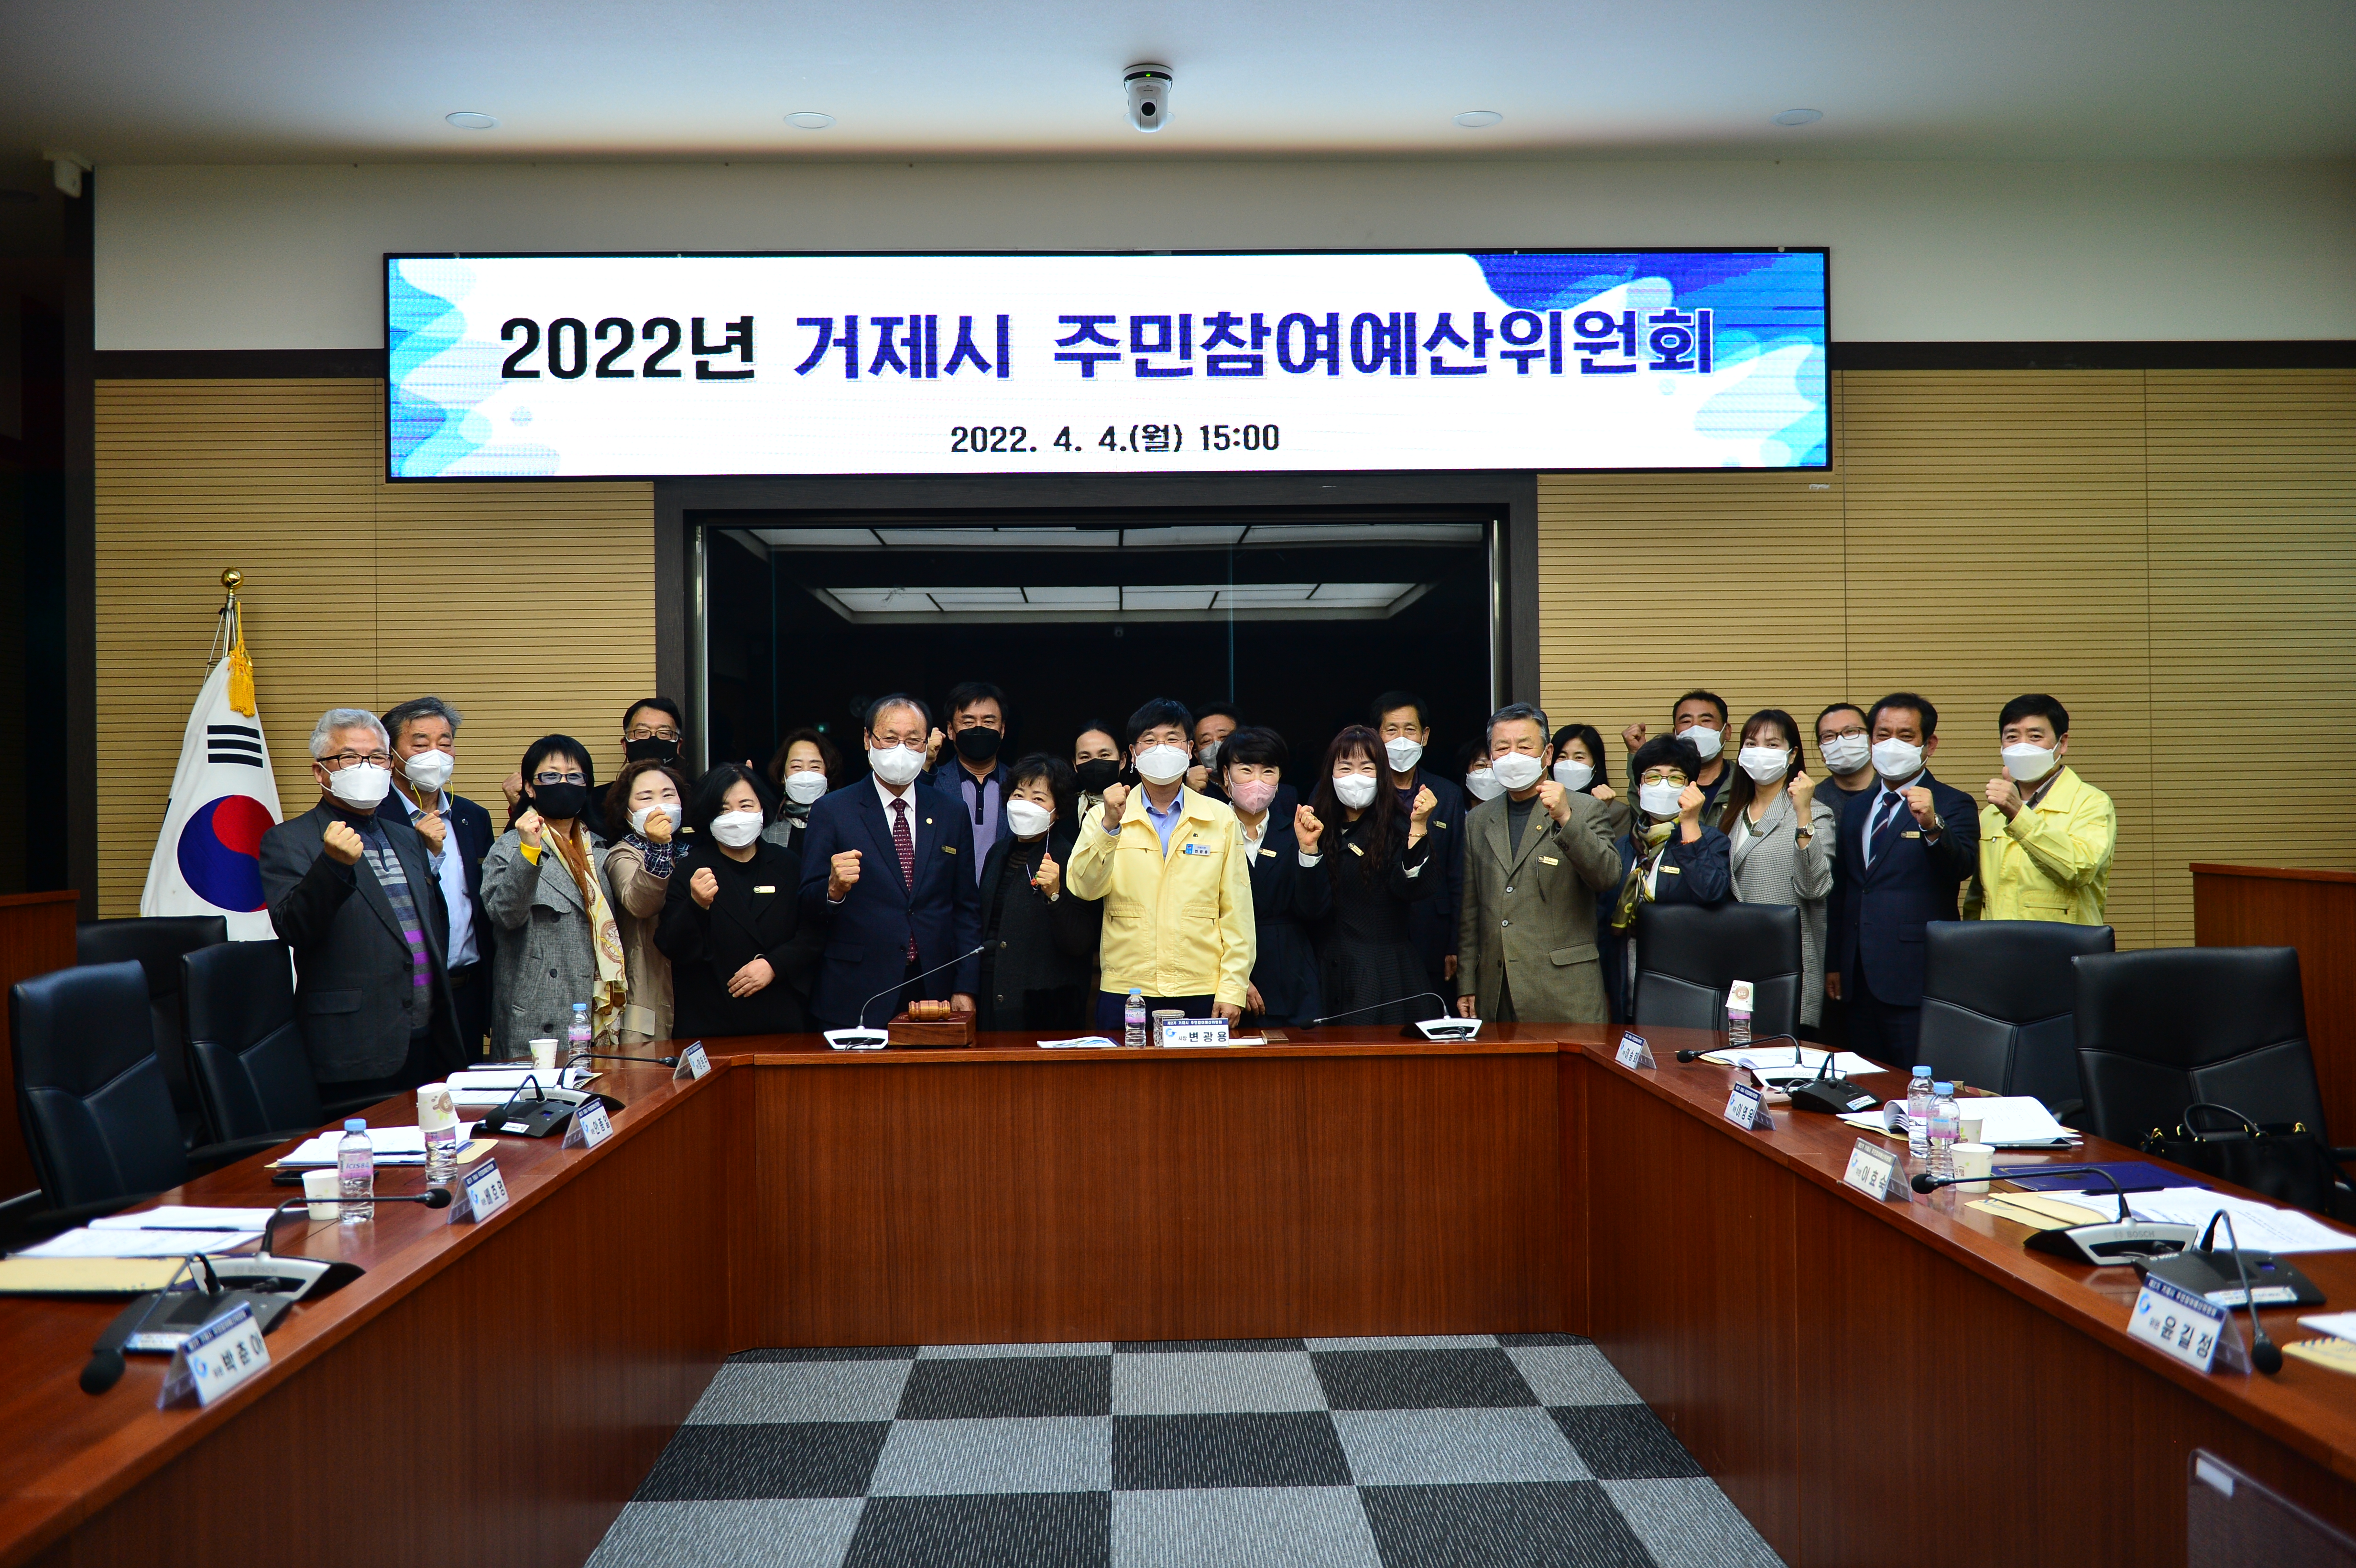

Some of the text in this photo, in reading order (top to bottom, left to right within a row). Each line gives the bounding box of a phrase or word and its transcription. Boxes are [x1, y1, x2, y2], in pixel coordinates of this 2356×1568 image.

[500, 309, 1712, 381] 2022년 거제시 주민참여예산위원회
[951, 425, 1037, 453] 2022.
[1053, 425, 1082, 453] 4.
[1200, 424, 1279, 451] 15:00
